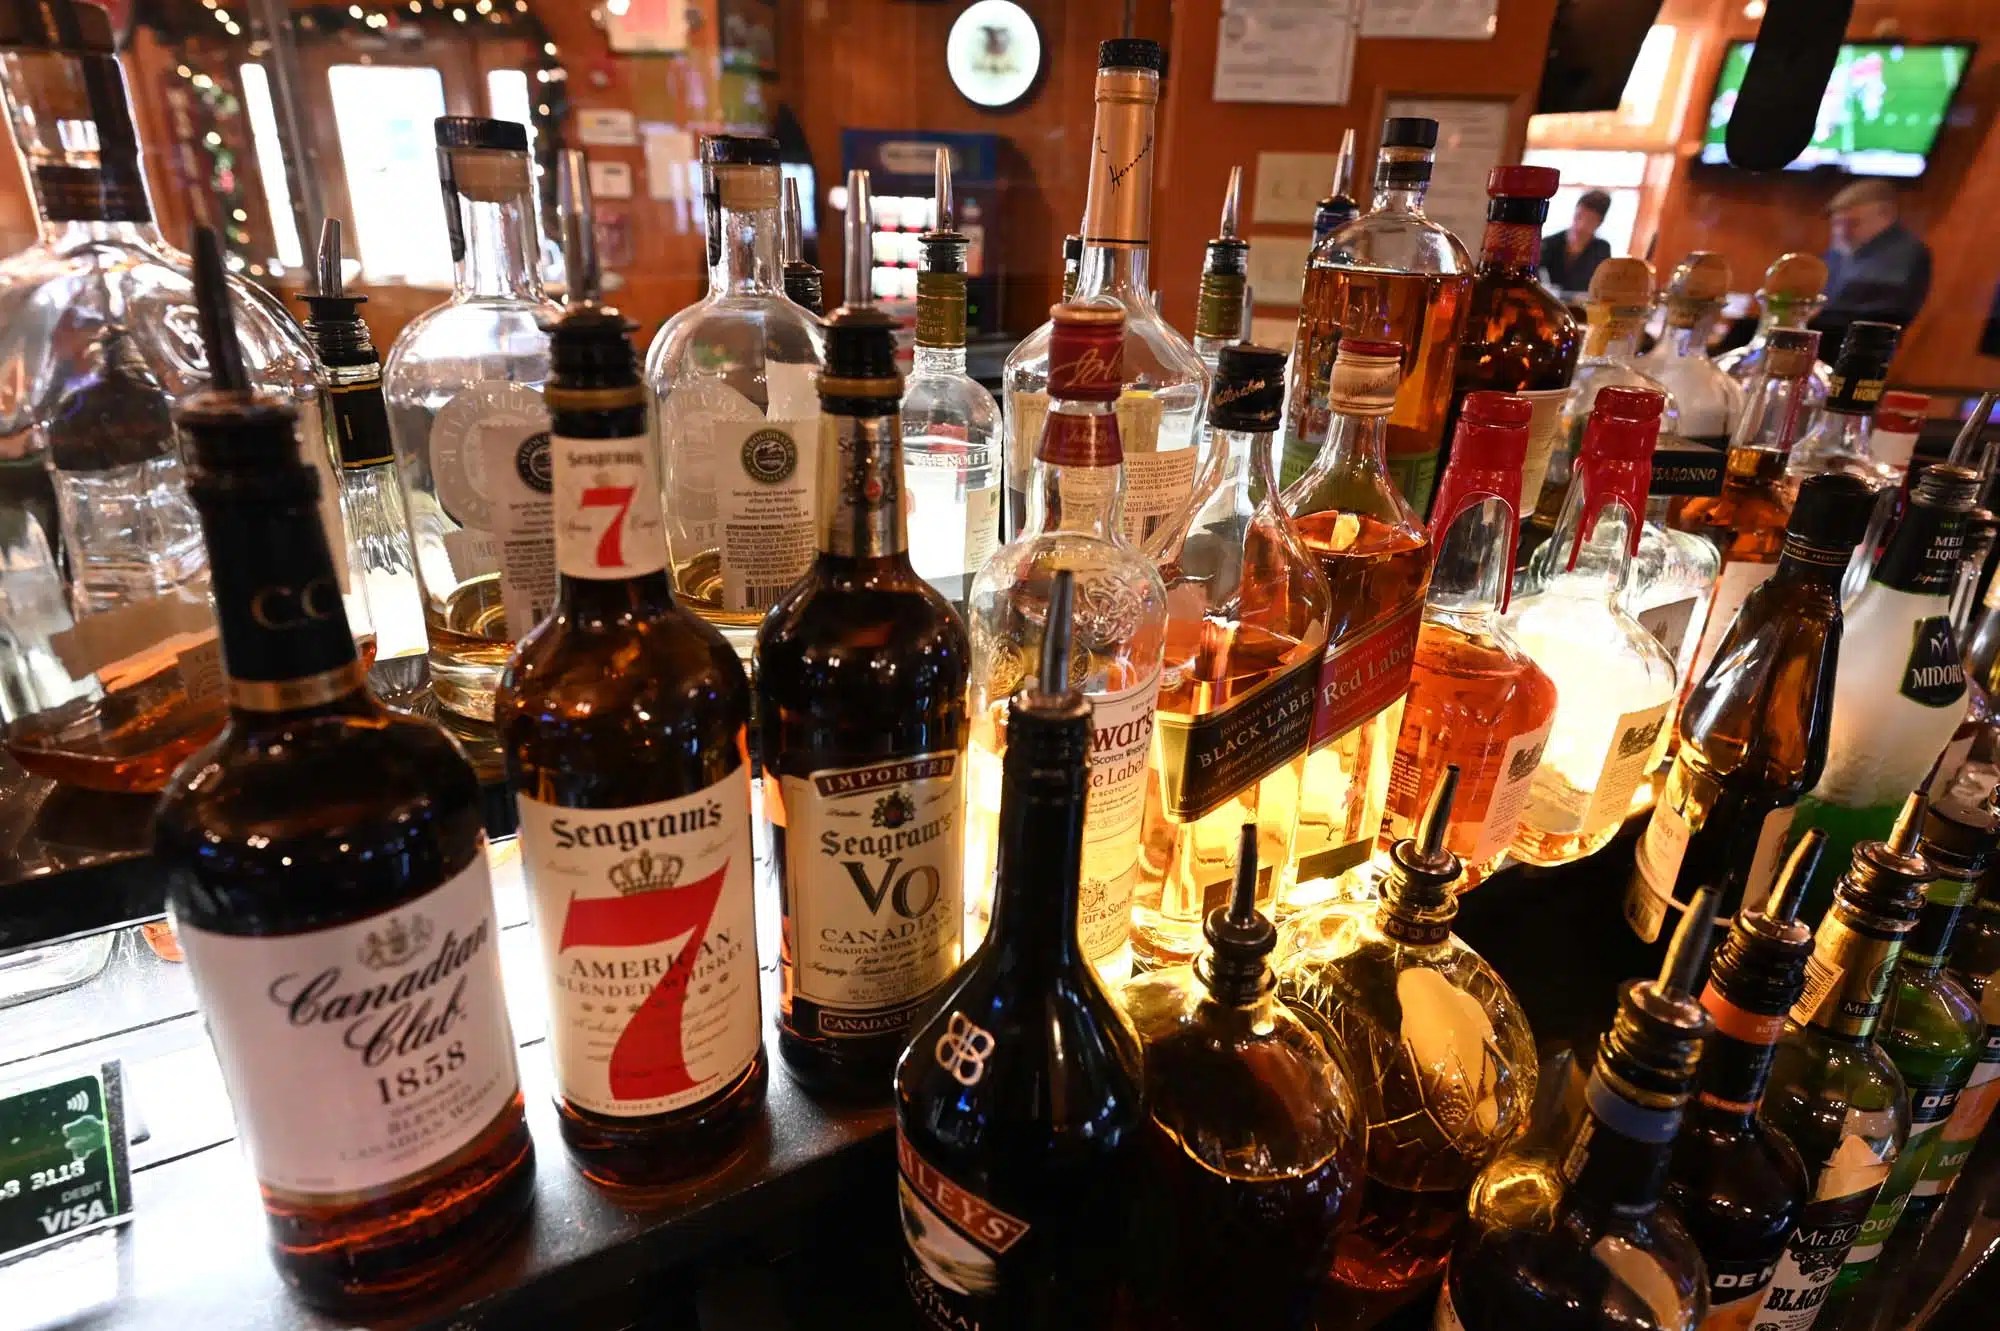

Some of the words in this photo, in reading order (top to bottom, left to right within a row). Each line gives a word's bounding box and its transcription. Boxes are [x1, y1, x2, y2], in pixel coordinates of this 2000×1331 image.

[578, 482, 638, 568] 7
[1322, 668, 1362, 707] Red
[1368, 634, 1415, 681] Label
[1912, 664, 1963, 689] MIDORI
[1092, 706, 1155, 753] war's
[1196, 722, 1261, 769] BLACK
[825, 756, 953, 793] IMPORTED
[1107, 753, 1145, 786] Label
[551, 800, 723, 852] Seagram's
[820, 814, 953, 860] Seagram's
[840, 857, 940, 919] VO
[820, 898, 953, 944] CANADIAN
[268, 916, 489, 1027] Canadian
[558, 856, 732, 1101] 7
[377, 1040, 467, 1105] 1858
[61, 1180, 104, 1204] DEBIT
[37, 1200, 108, 1235] VISA
